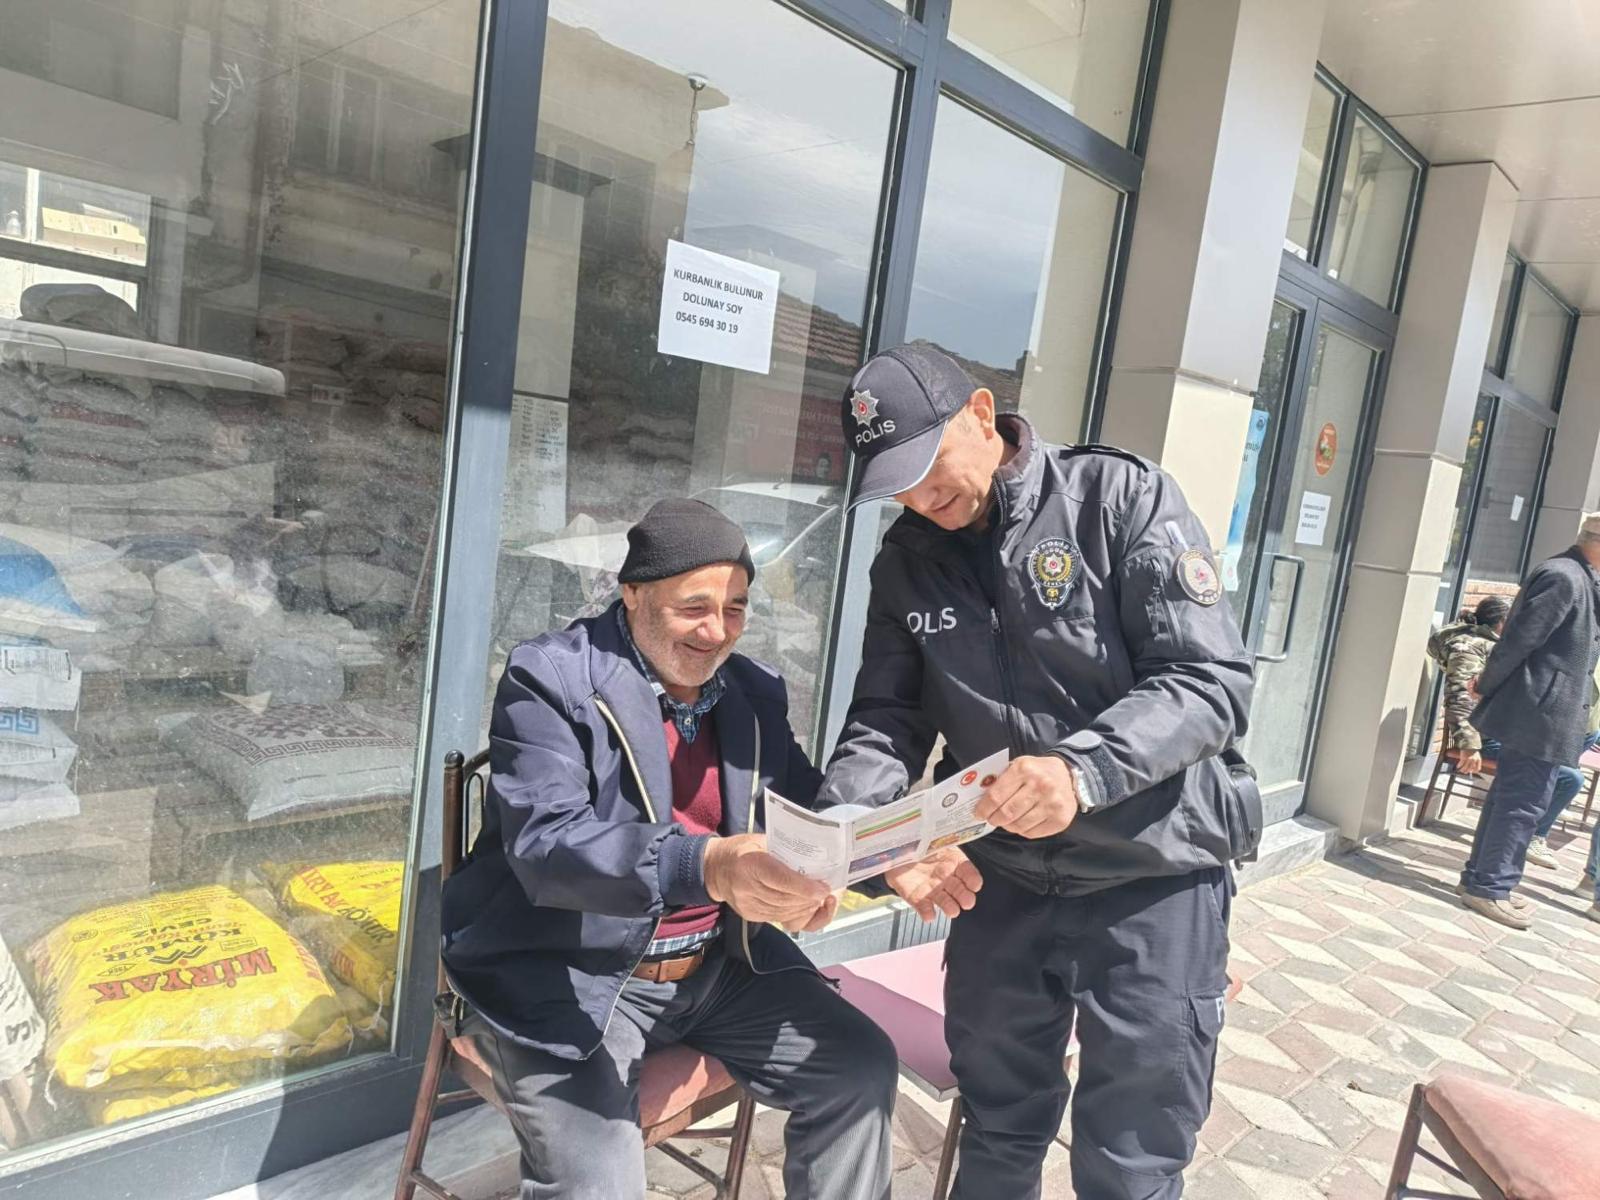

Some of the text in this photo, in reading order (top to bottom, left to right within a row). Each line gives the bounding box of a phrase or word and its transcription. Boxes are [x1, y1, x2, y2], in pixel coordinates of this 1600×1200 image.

[673, 268, 764, 301] KURBANLIK BULUNUR
[682, 291, 743, 315] DOLUNAY SOY
[675, 311, 738, 334] 0545 694 30 19
[855, 419, 897, 448] POLIS
[906, 606, 958, 634] OLIS
[103, 928, 242, 962] KÖMÜR
[89, 946, 278, 1005] MİRYAK
